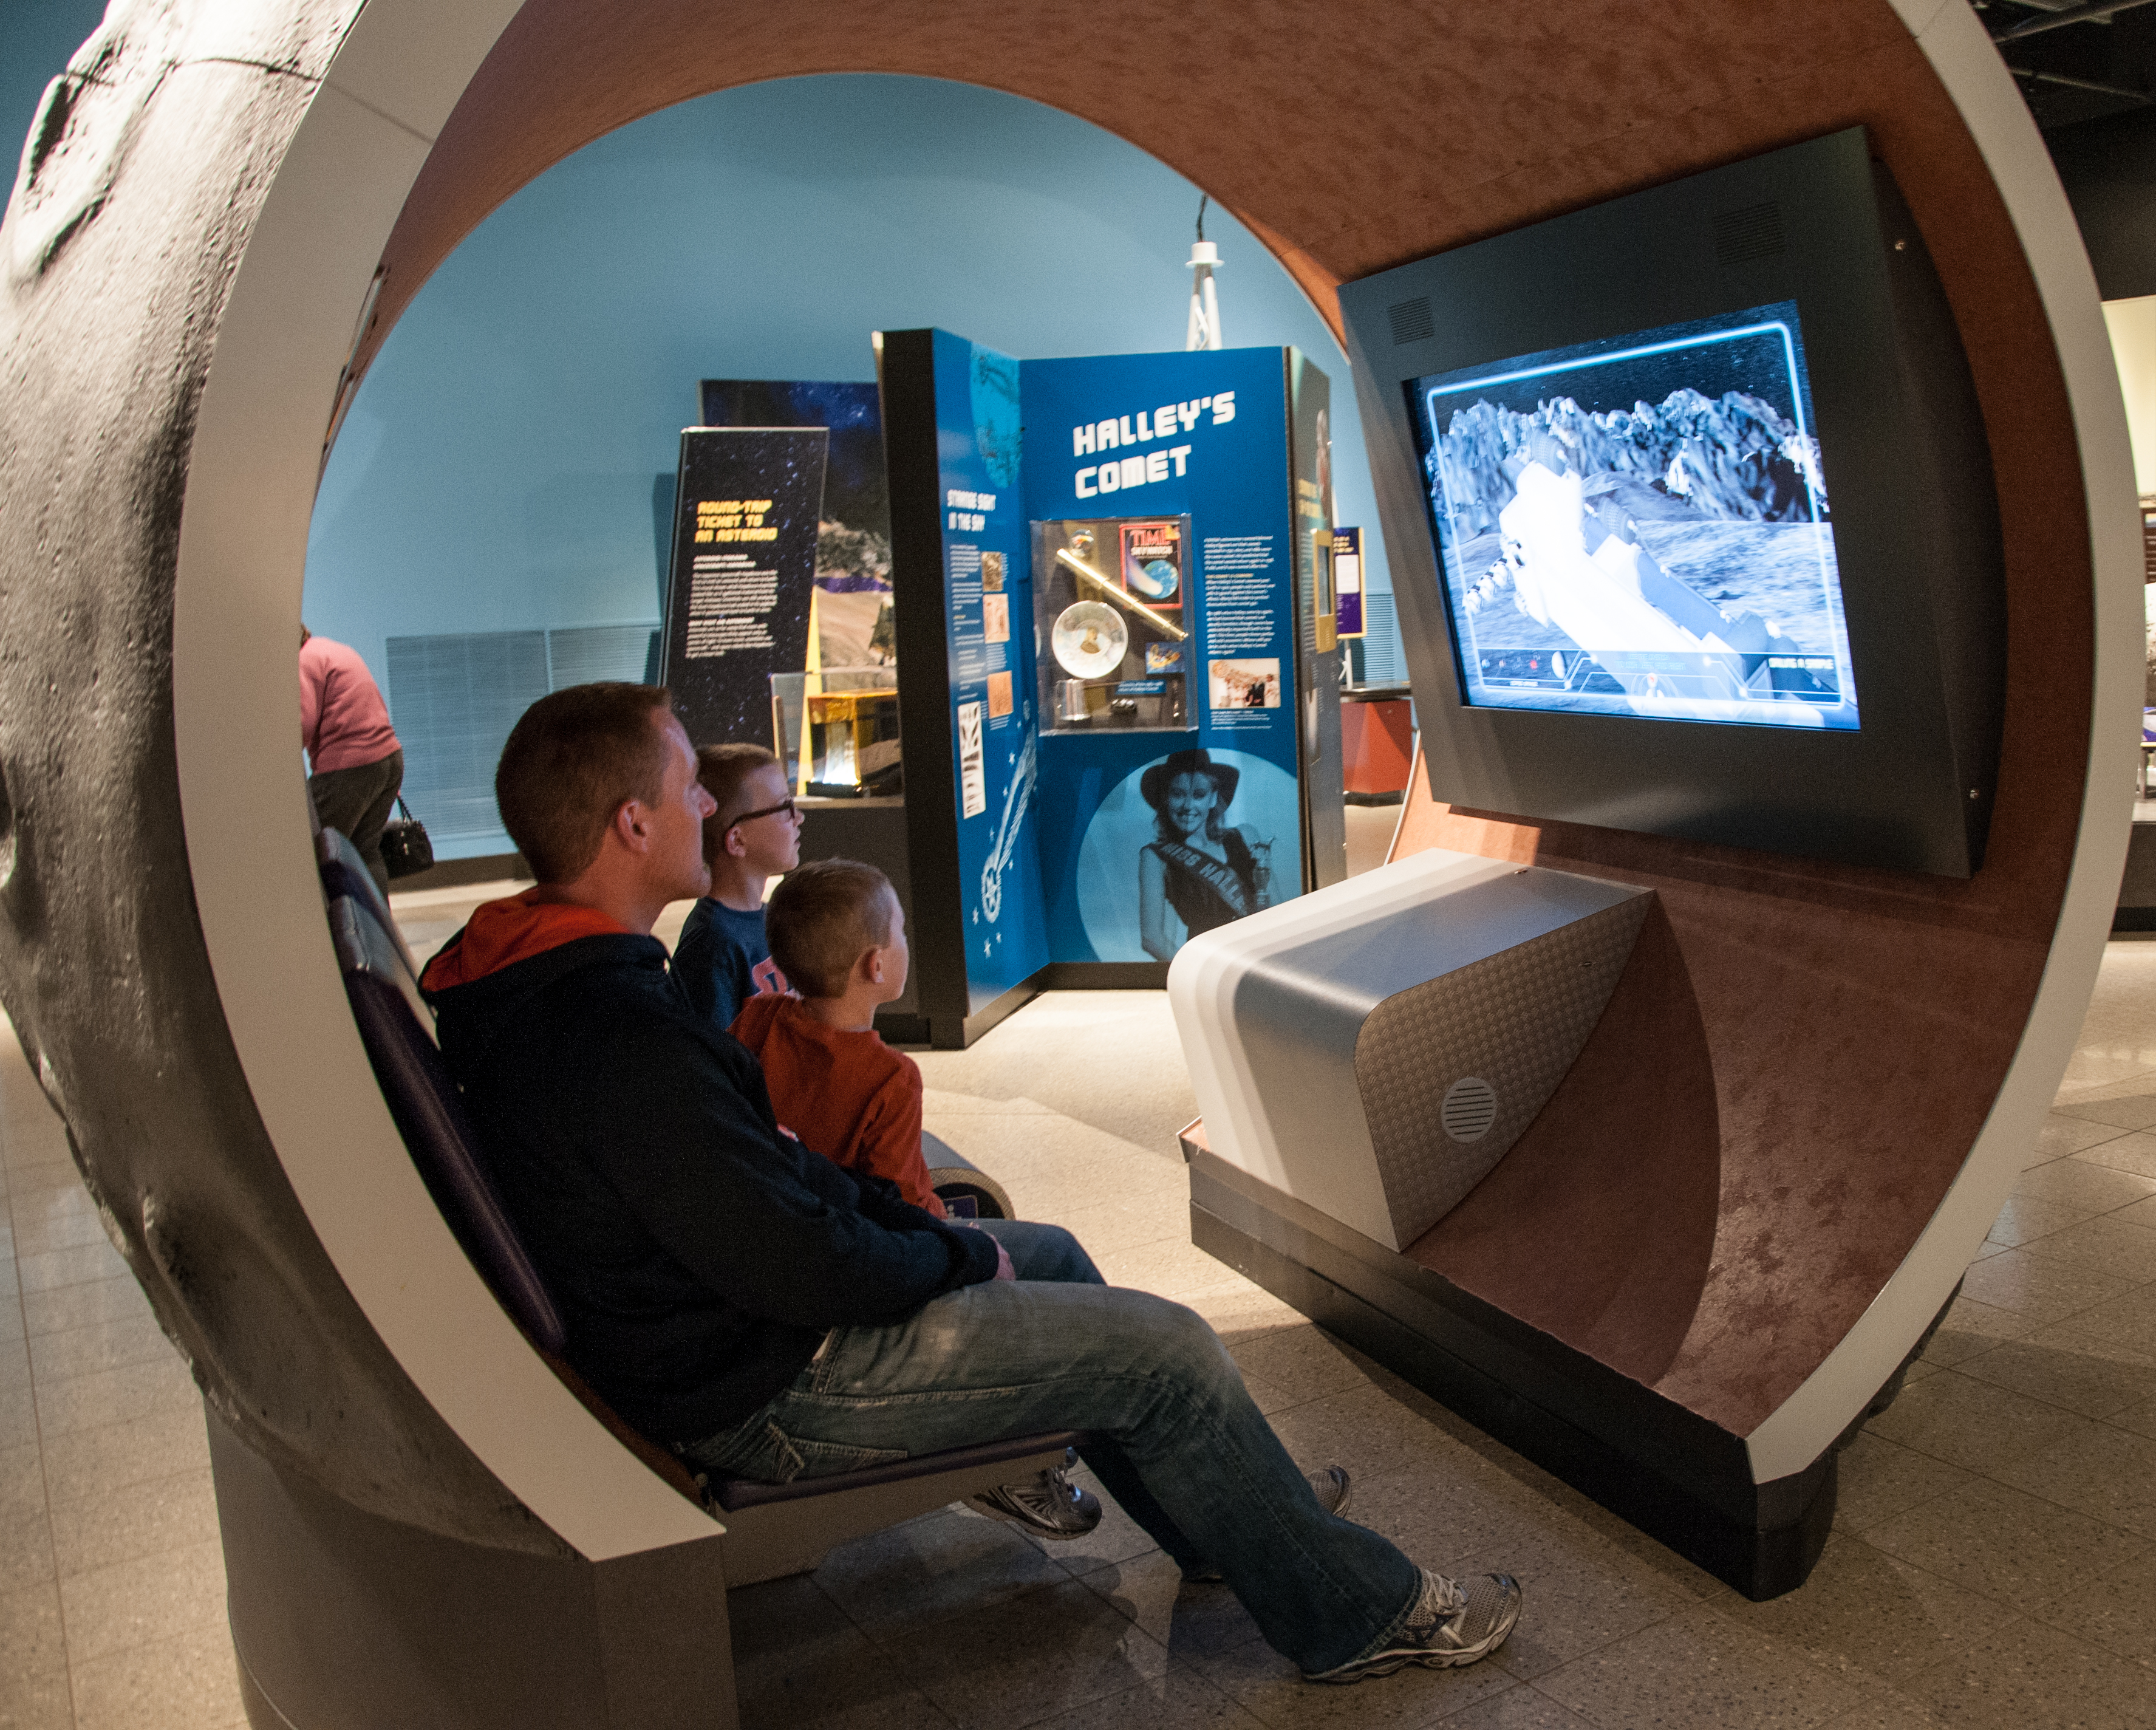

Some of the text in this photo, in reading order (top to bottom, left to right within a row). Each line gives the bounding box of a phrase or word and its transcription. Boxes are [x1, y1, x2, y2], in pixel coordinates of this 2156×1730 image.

[1073, 391, 1236, 457] HALLEY'S
[1074, 444, 1192, 499] COMET
[697, 499, 773, 515] ROUND-TRIP
[697, 513, 763, 529] TICKET TO
[694, 526, 778, 543] AN ASTEROID
[1130, 529, 1172, 546] TIME
[1161, 843, 1247, 915] MISS HALLE
